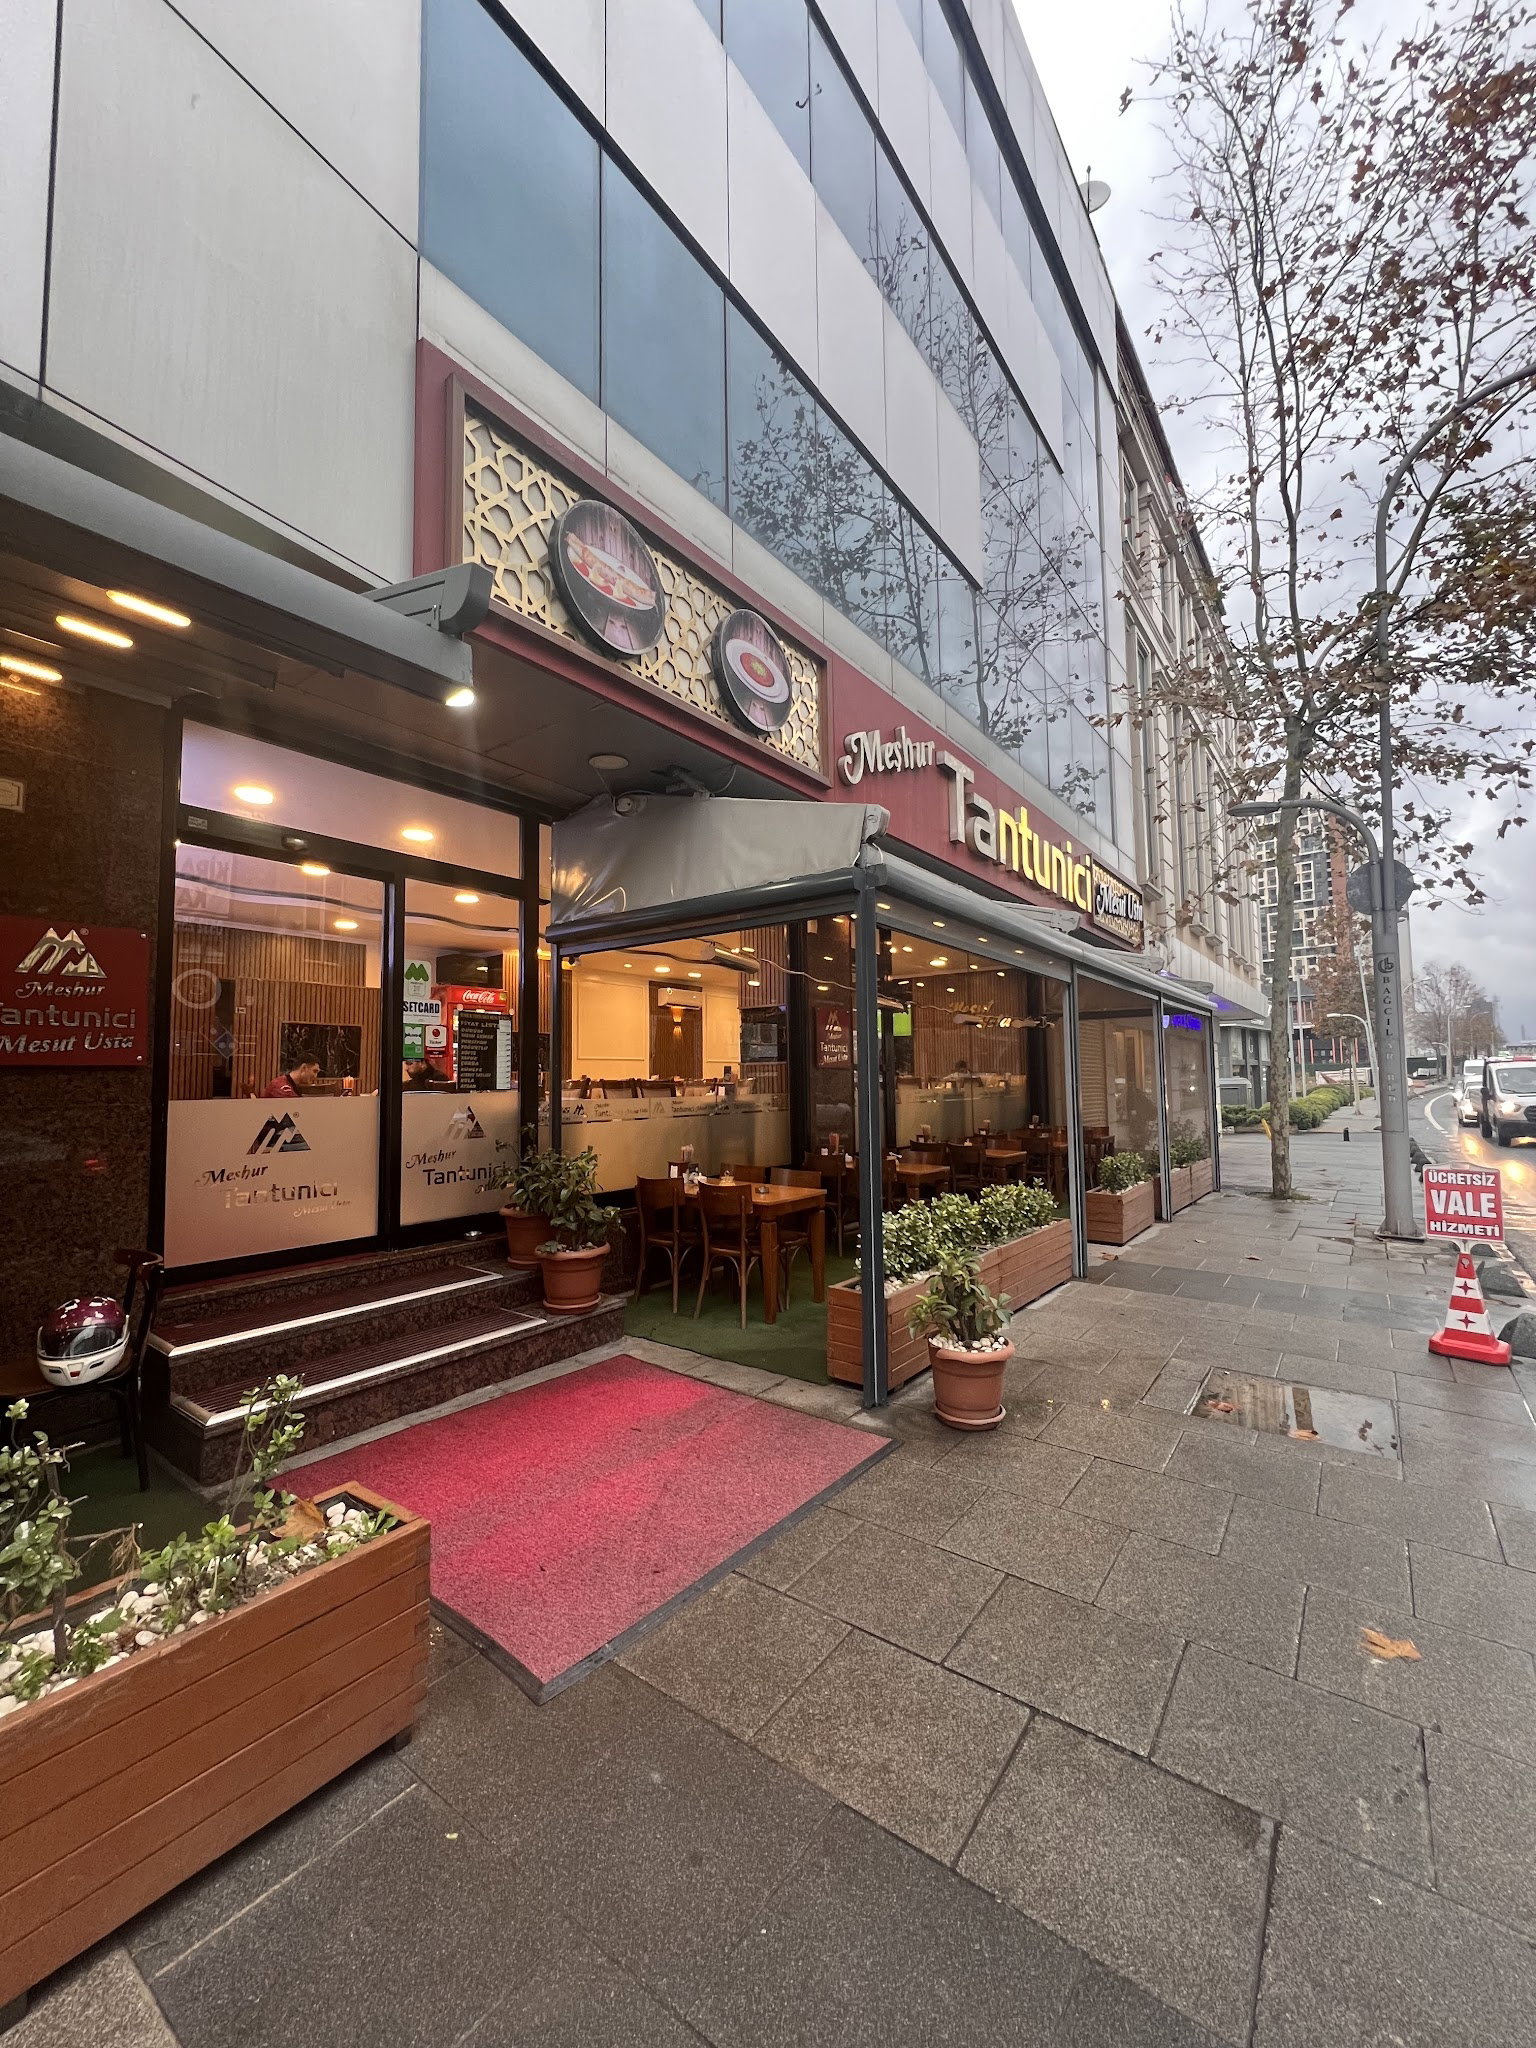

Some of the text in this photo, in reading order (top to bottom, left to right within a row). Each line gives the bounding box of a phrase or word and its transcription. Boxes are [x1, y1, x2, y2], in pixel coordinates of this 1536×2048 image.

[838, 725, 936, 786] Meşhur
[936, 750, 1093, 913] Tantunici
[403, 1001, 440, 1014] SETCARD
[84, 1032, 135, 1050] Usta
[1428, 1169, 1495, 1187] ÜCRETSİZ
[1430, 1189, 1497, 1218] VALE
[1429, 1220, 1500, 1237] HİZMETİ
